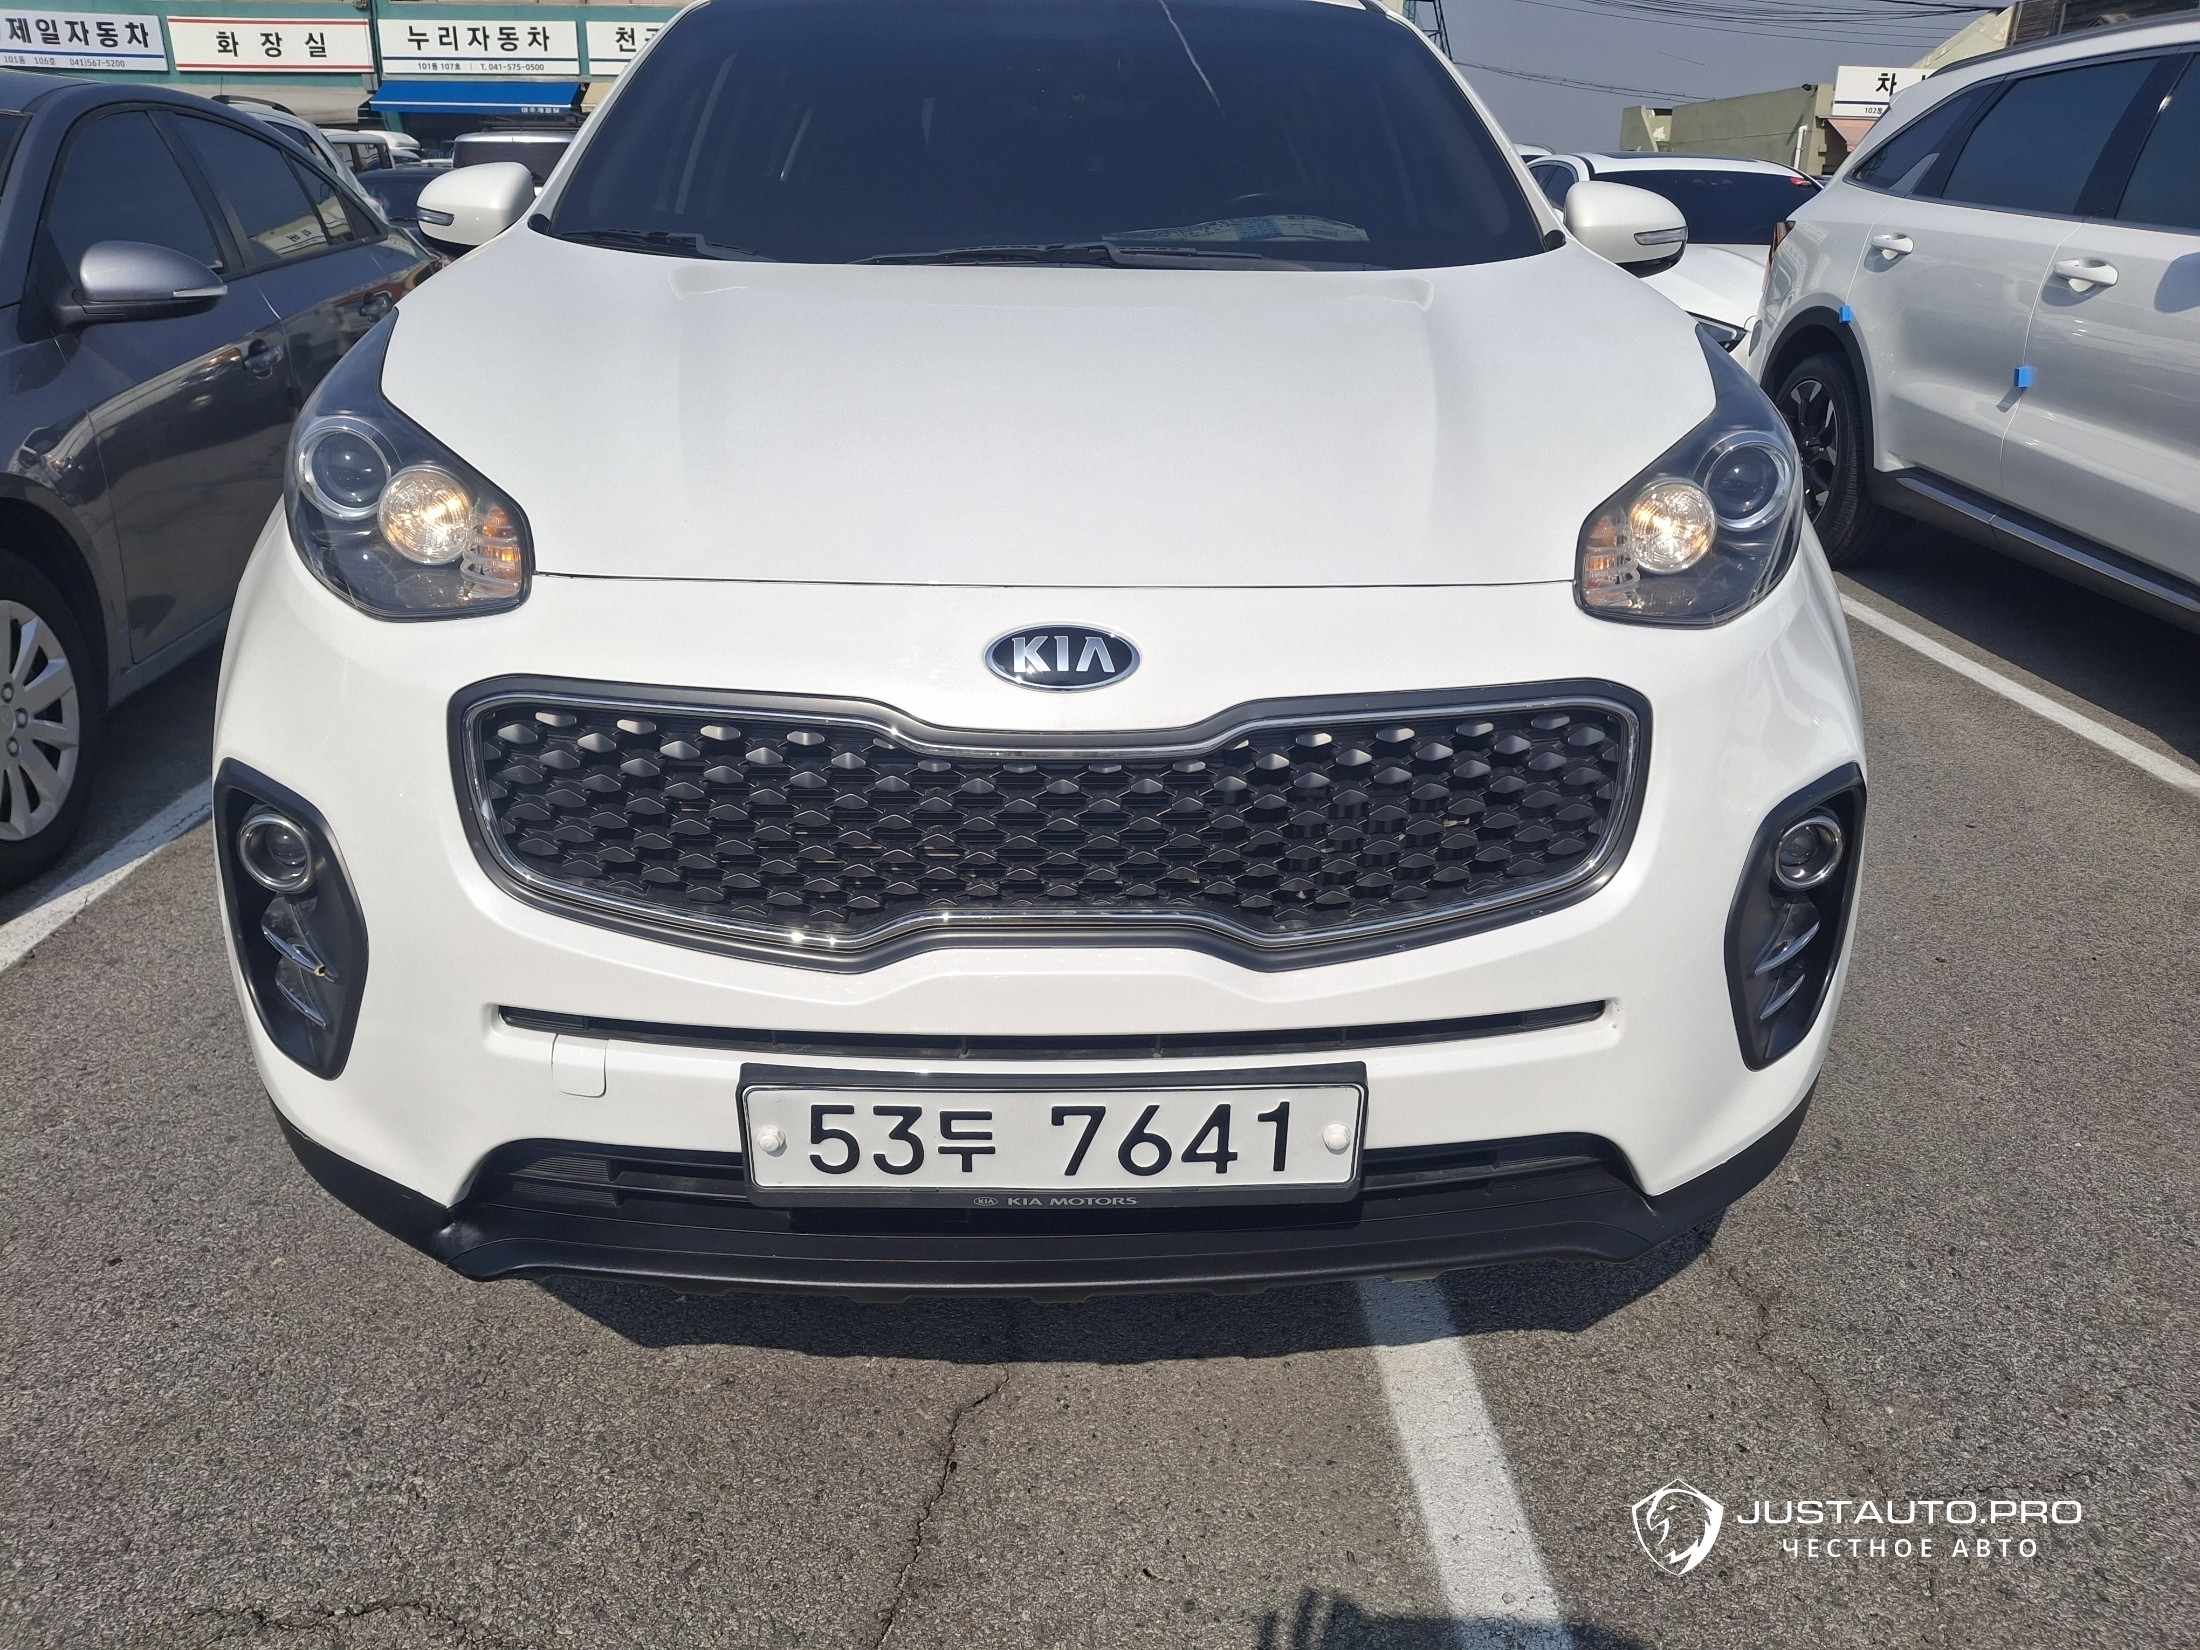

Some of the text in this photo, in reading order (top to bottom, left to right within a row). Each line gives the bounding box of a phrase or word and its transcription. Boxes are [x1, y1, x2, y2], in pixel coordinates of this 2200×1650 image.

[5, 17, 149, 48] 제일자동차
[406, 25, 550, 51] 누리자동차
[69, 58, 126, 68] 041)567-5200
[1011, 635, 1116, 673] KIA
[808, 1101, 1291, 1177] 53두 7641
[1007, 1197, 1043, 1206] KIA
[1049, 1196, 1138, 1206] MOTORS
